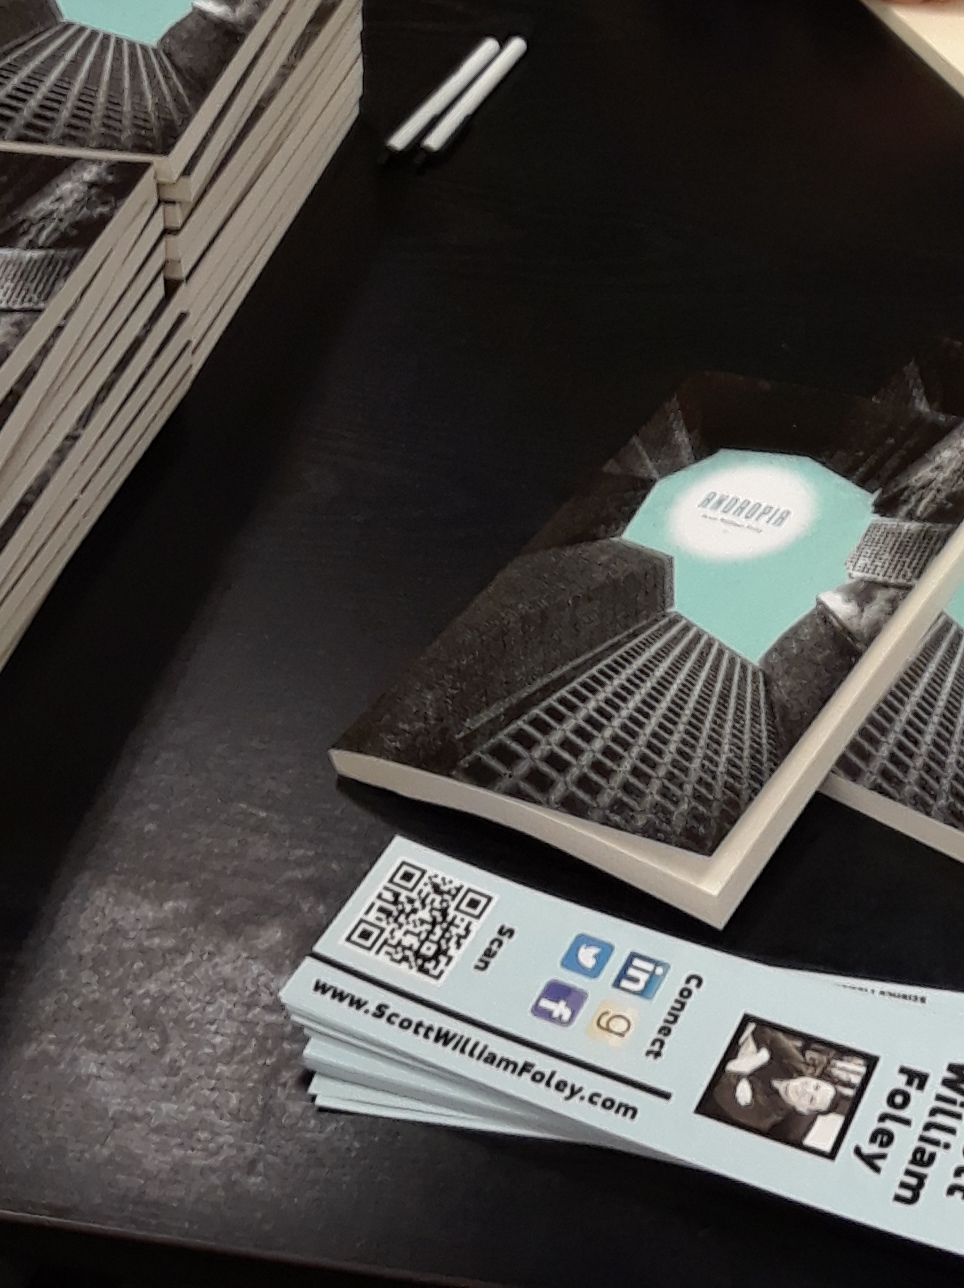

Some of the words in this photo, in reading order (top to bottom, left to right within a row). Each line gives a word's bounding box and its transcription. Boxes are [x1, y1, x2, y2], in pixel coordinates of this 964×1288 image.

[697, 491, 791, 527] ANDROPIA
[473, 923, 516, 973] Scan
[312, 977, 639, 1121] www.ScottWilliamFoley.com
[644, 973, 704, 1061] Connect
[853, 1065, 930, 1175] Foley
